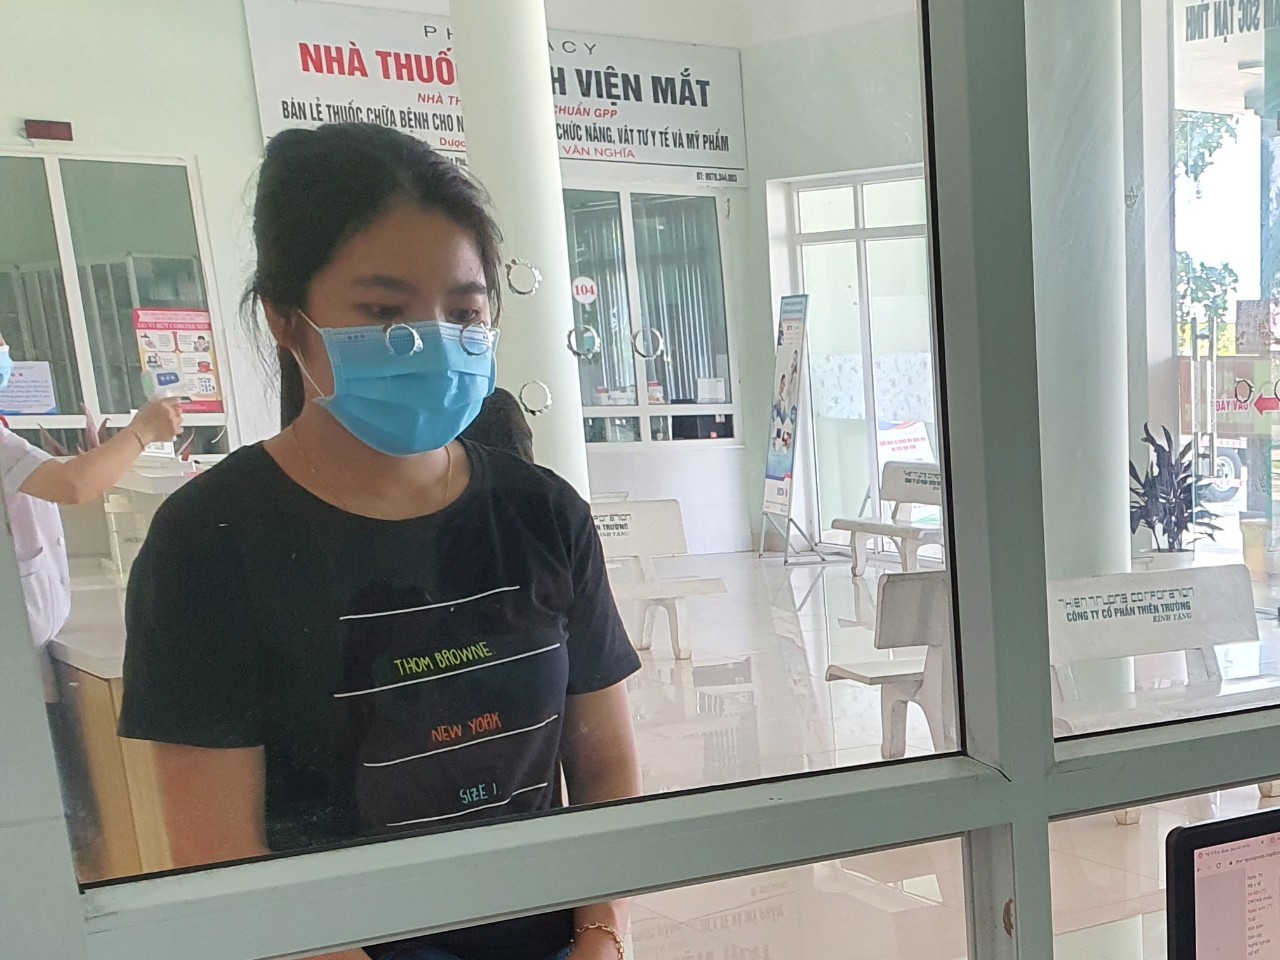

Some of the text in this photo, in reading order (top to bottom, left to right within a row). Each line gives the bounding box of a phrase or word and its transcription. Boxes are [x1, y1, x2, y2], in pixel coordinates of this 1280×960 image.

[299, 41, 369, 78] NHÀ
[375, 47, 460, 86] THUỐ
[575, 65, 643, 106] VIỆN
[651, 67, 711, 107] MẮT
[417, 92, 444, 105] NHÀ
[594, 107, 618, 119] GPP
[400, 107, 430, 133] BỆNH
[432, 114, 454, 132] CHO
[650, 131, 658, 147] Y
[574, 284, 595, 296] 104
[1090, 610, 1100, 621] TY
[393, 656, 434, 676] THOM
[431, 712, 502, 742] NEW YORK
[459, 783, 489, 804] SIZE
